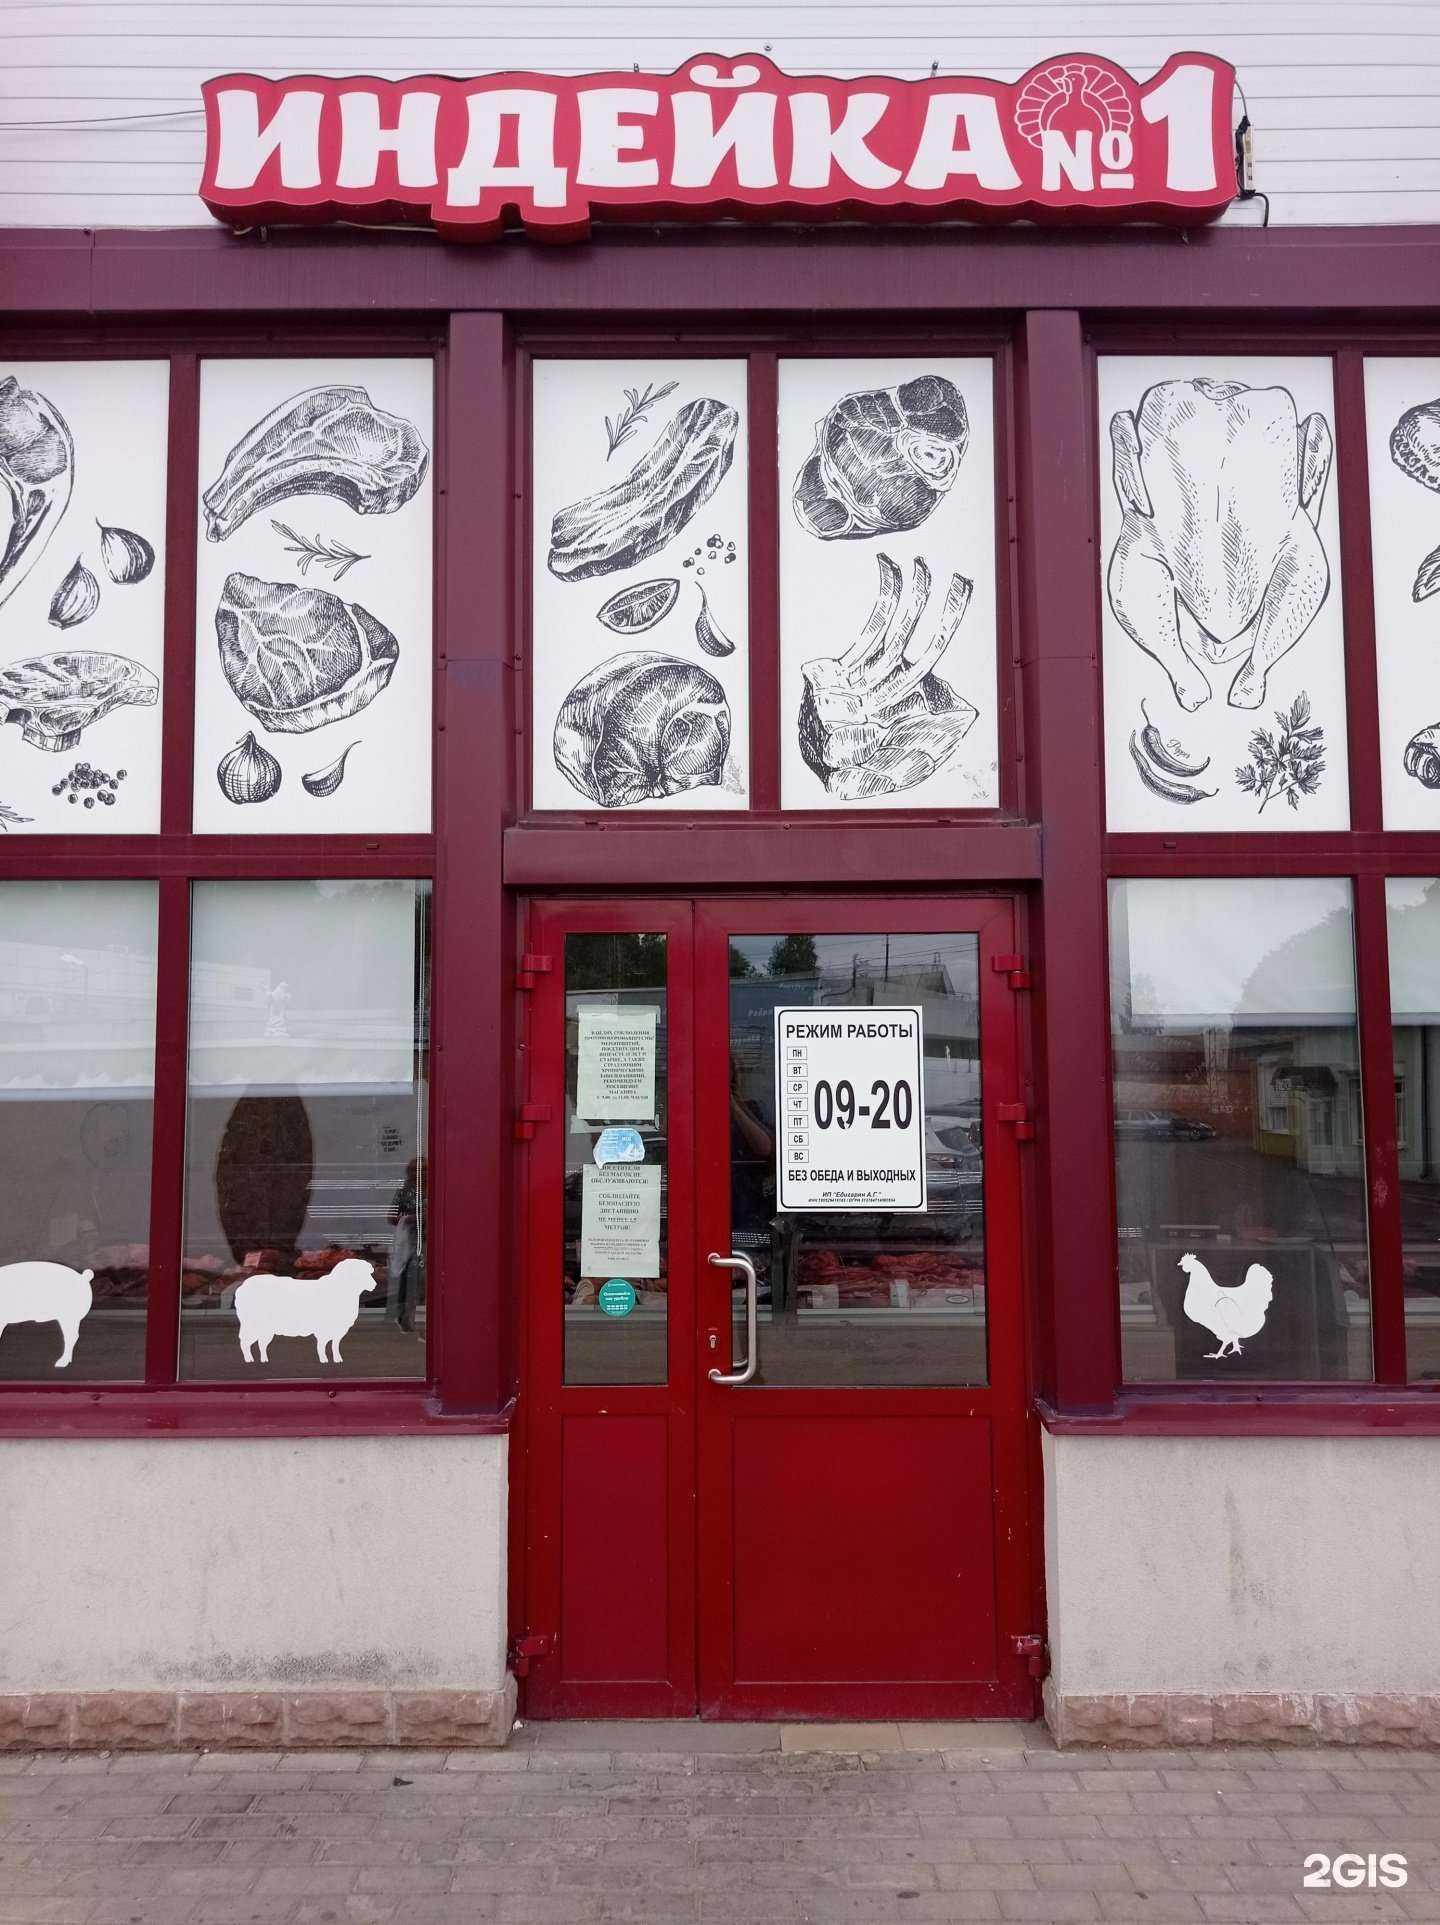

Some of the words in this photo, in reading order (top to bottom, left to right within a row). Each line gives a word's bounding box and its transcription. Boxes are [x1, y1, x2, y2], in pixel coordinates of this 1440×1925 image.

[214, 62, 1022, 210] ИНДЕЙКА
[786, 1024, 842, 1038] РЕЖИМ
[847, 1024, 913, 1038] РАБОТЫ
[792, 1049, 803, 1058] ПН
[792, 1066, 802, 1075] ВТ
[793, 1083, 803, 1092] СР
[793, 1100, 803, 1109] ЧТ
[814, 1079, 913, 1130] 09-20
[793, 1117, 803, 1127] ПТ
[793, 1135, 804, 1144] СБ
[793, 1152, 804, 1161] ВС
[788, 1169, 808, 1182] БЕЗ
[810, 1169, 845, 1183] ОБЕДА
[847, 1169, 854, 1181] И
[856, 1169, 916, 1183] ВЫХОДНЫХ
